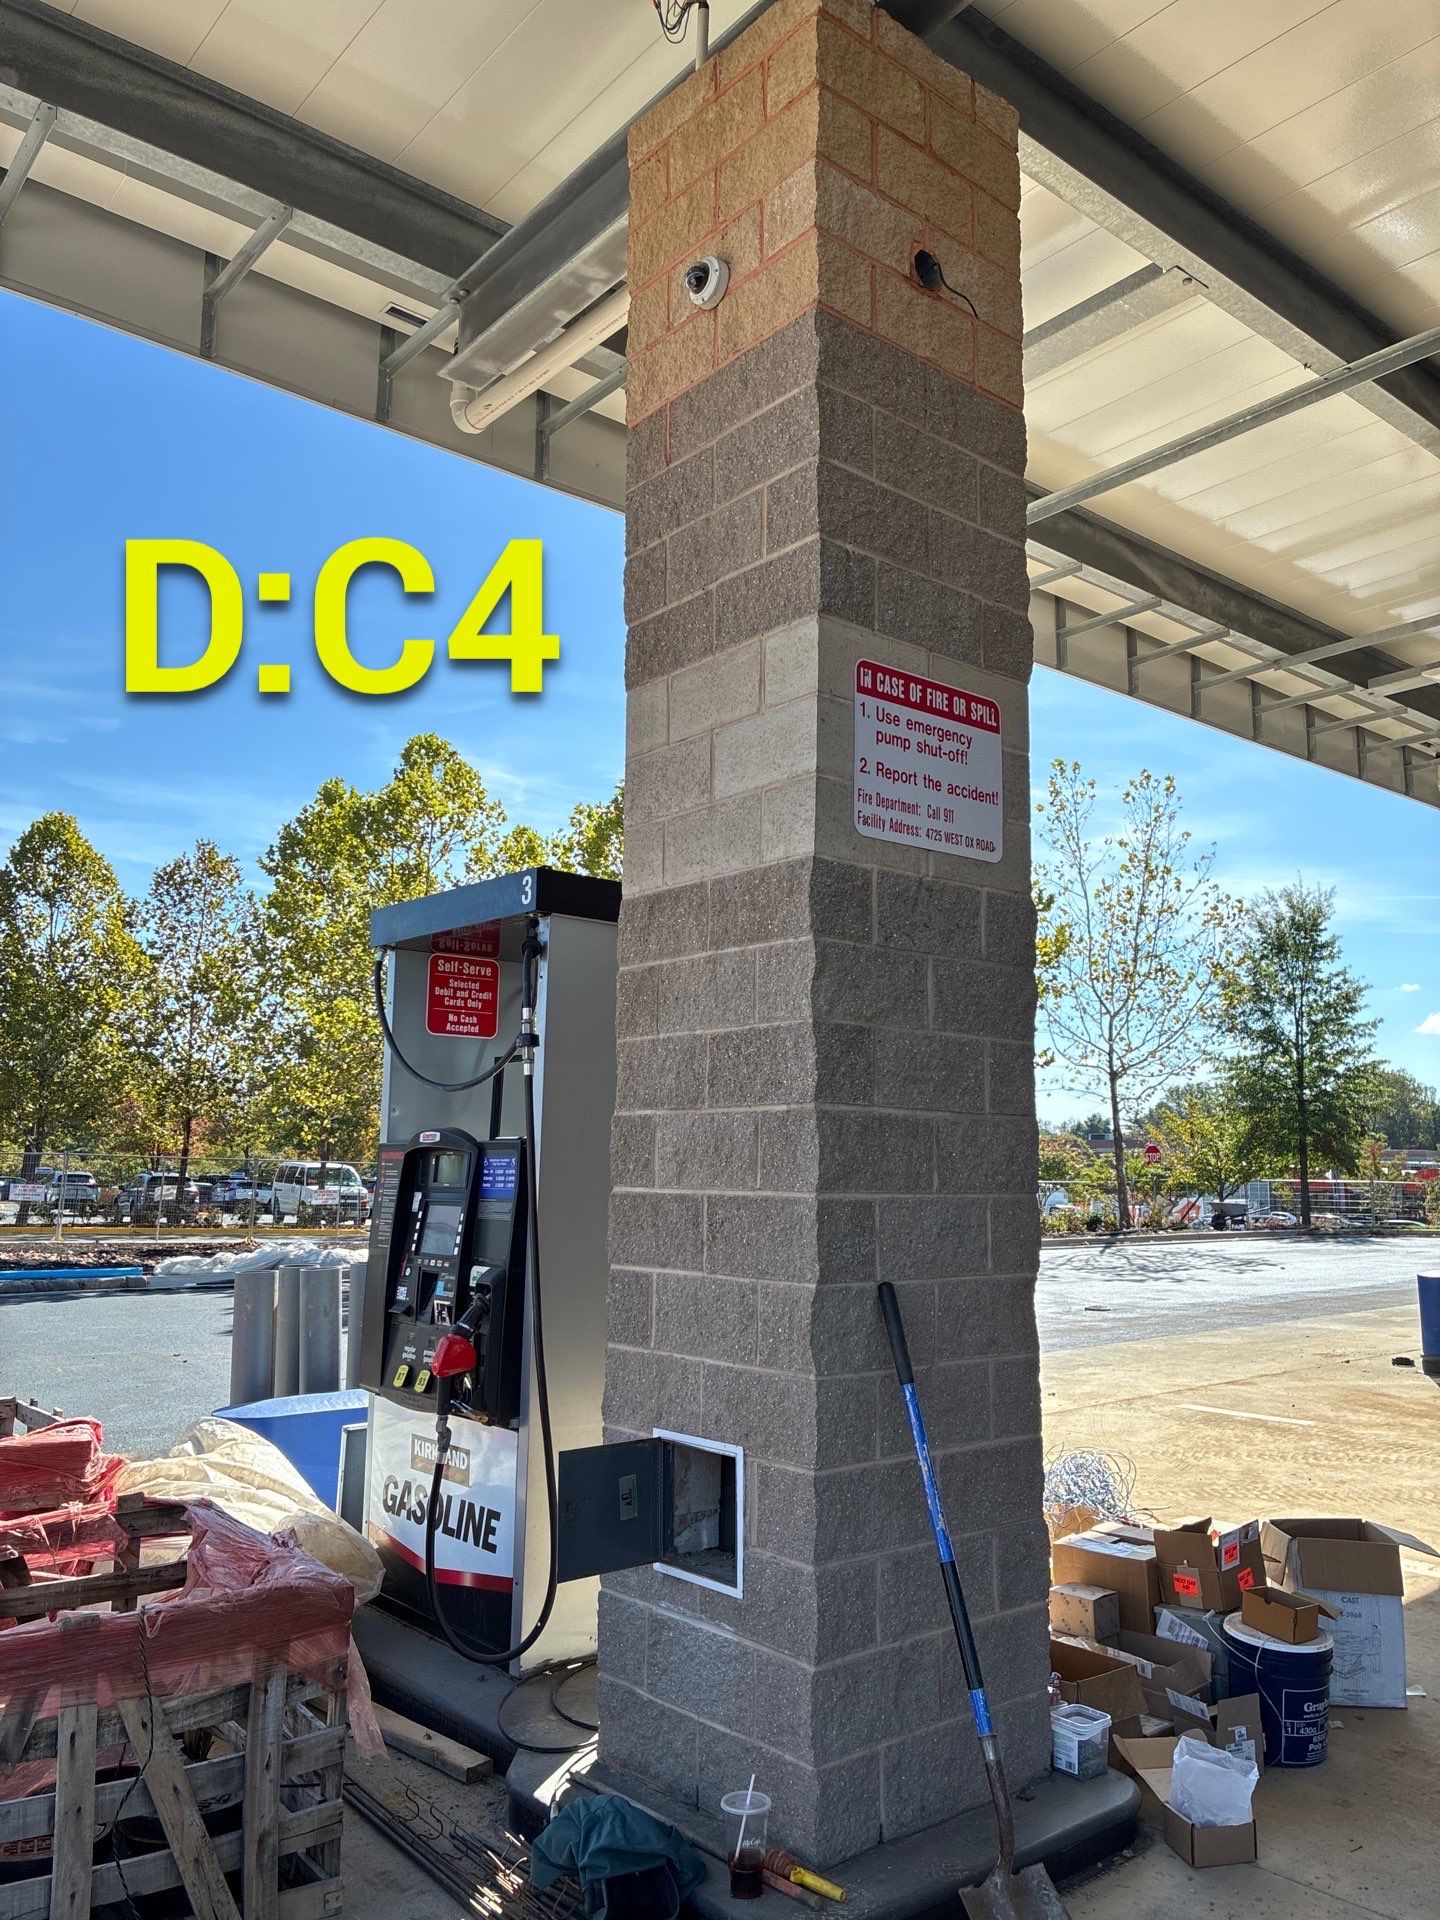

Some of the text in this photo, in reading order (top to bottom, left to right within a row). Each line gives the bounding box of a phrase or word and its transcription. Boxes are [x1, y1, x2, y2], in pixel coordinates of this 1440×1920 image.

[860, 667, 997, 727] IN CASE OF FIRE OR SPILL
[860, 701, 973, 749] 1. Use emergency
[876, 729, 968, 766] pump shut-off!
[859, 757, 999, 806] 2. Report the accident!
[857, 788, 954, 823] Fire Department: Call 911
[857, 810, 996, 853] Facility Address: 4725 WEST OX ROAD
[521, 875, 532, 905] 3
[437, 959, 492, 977] Self-Serve
[435, 987, 492, 1000] Debit and Credit
[449, 979, 480, 990] Selected
[444, 997, 482, 1009] Cards Only
[446, 1022, 479, 1033] Accepted
[448, 1013, 477, 1024] No Cash
[1145, 1152, 1161, 1162] STOP
[414, 1439, 468, 1470] KIRKAND
